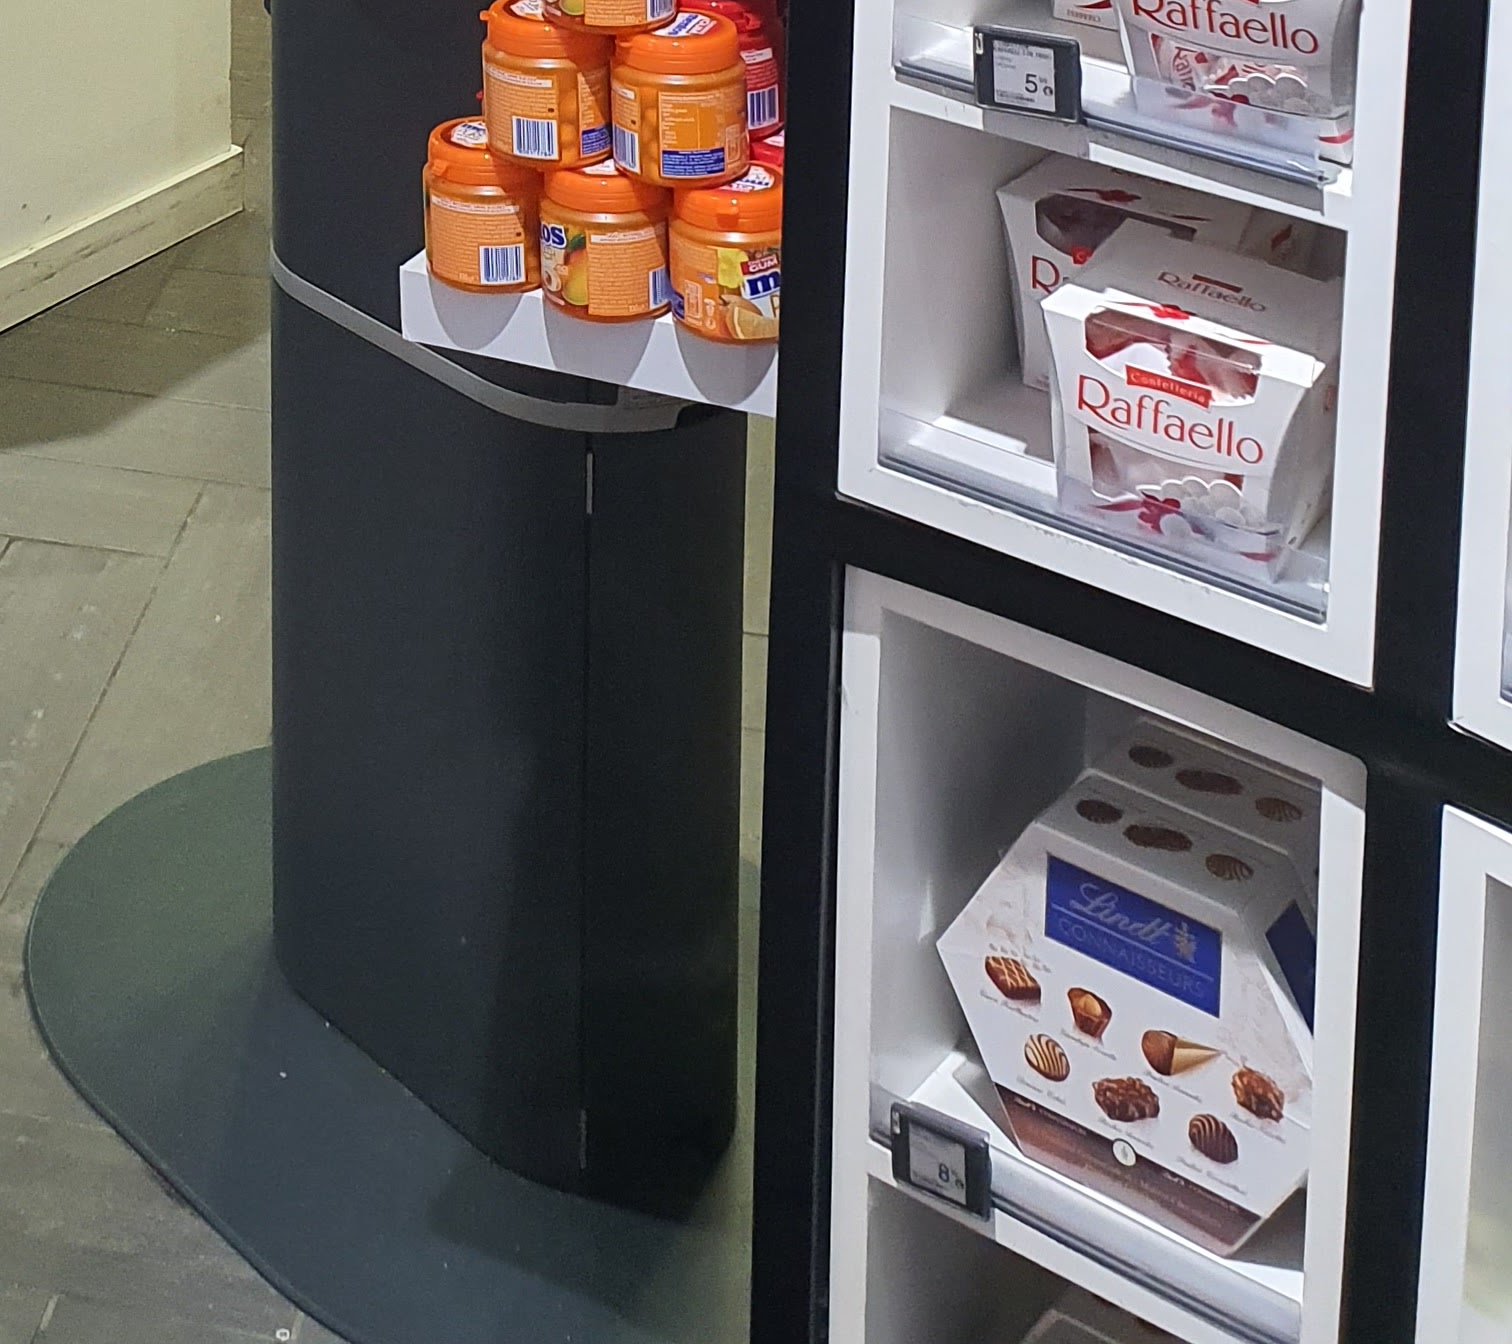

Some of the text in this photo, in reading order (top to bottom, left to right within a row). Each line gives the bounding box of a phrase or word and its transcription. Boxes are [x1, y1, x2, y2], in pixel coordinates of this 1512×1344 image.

[749, 259, 778, 273] GUM
[1157, 271, 1266, 312] Raffaello
[1078, 374, 1264, 463] Raffaello
[1069, 883, 1173, 944] Lindt
[1059, 919, 1206, 997] CONNAISSEURS
